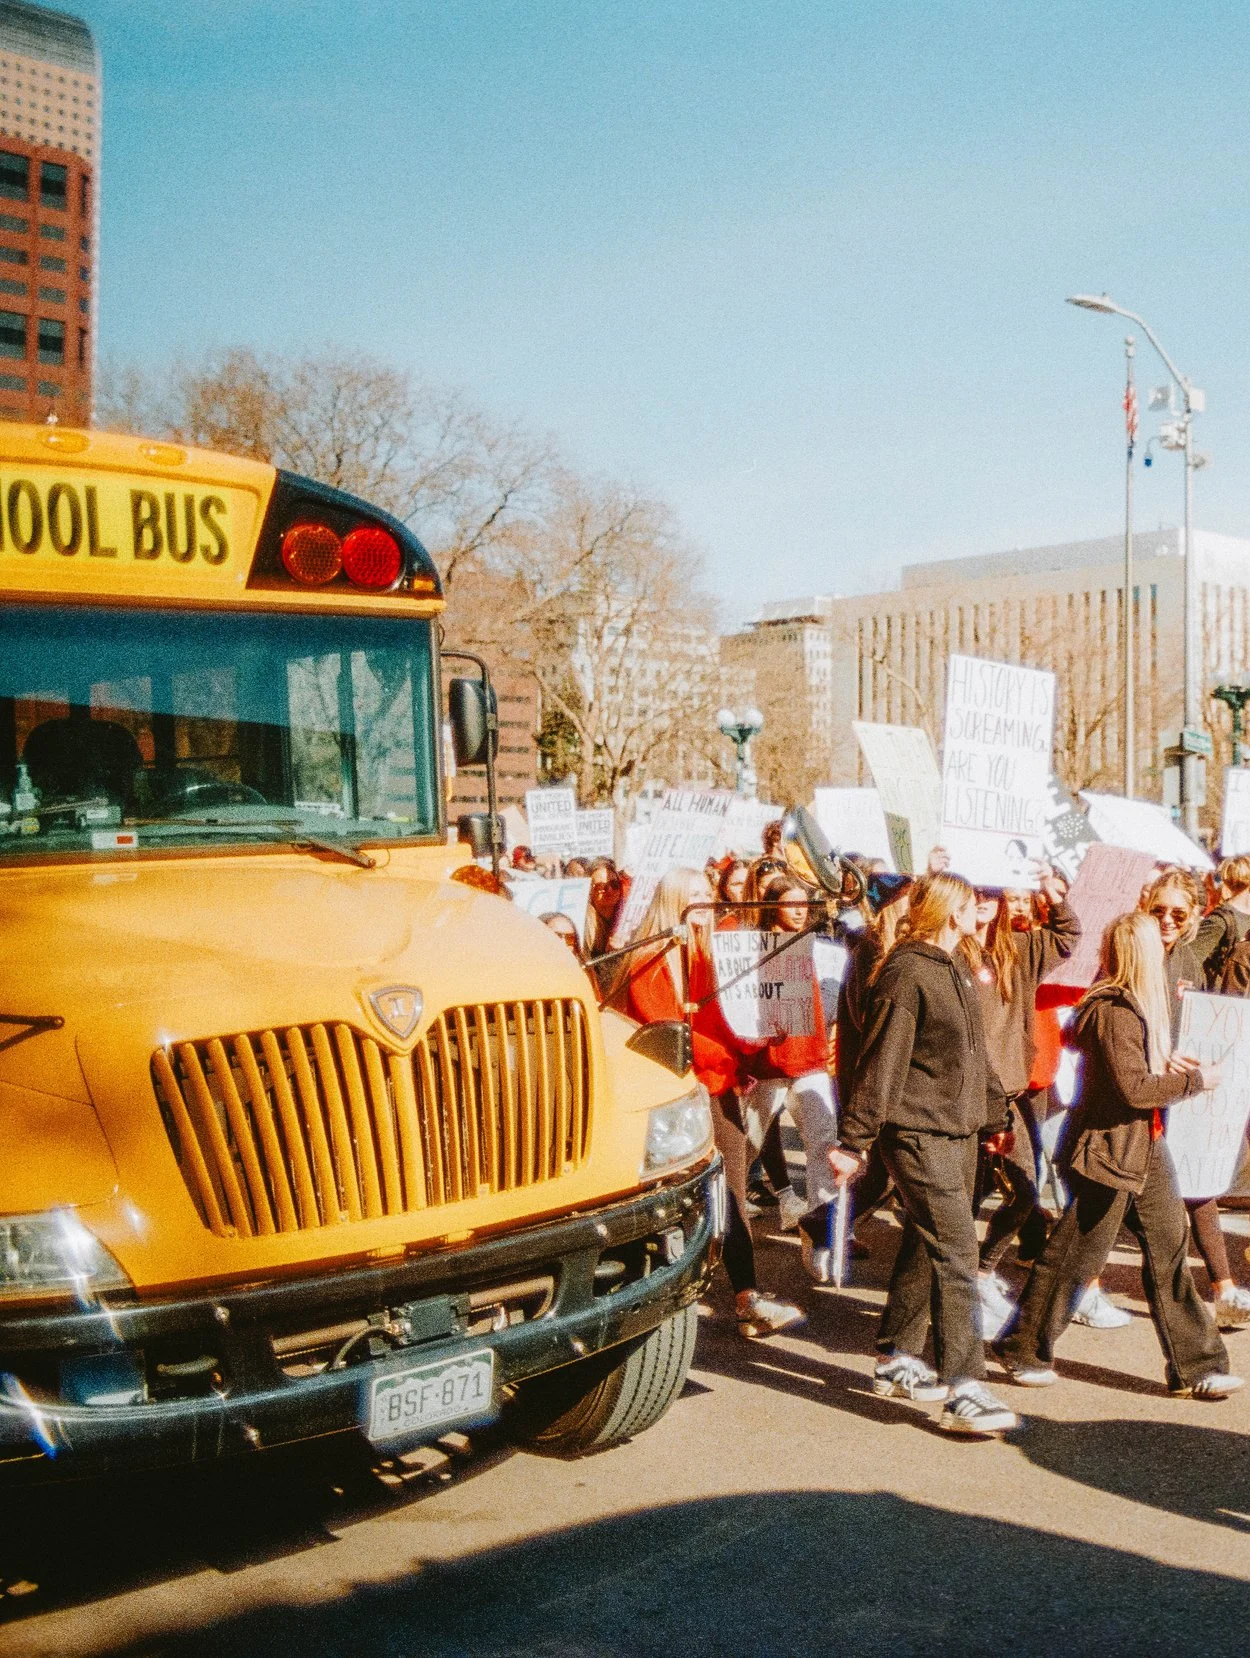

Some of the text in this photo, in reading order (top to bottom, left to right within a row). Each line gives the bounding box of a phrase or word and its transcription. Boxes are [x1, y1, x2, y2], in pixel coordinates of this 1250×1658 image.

[0, 478, 229, 567] OOL BUS
[951, 659, 1050, 717] HISTORY IS
[945, 750, 1017, 792] ARE YOU
[530, 799, 572, 814] UNITED
[688, 794, 732, 817] HUMAN
[713, 932, 781, 953] THIS ISN'T
[718, 956, 752, 977] ABOUT
[744, 981, 785, 1000] ABOUT
[402, 1405, 462, 1428] COLORADO
